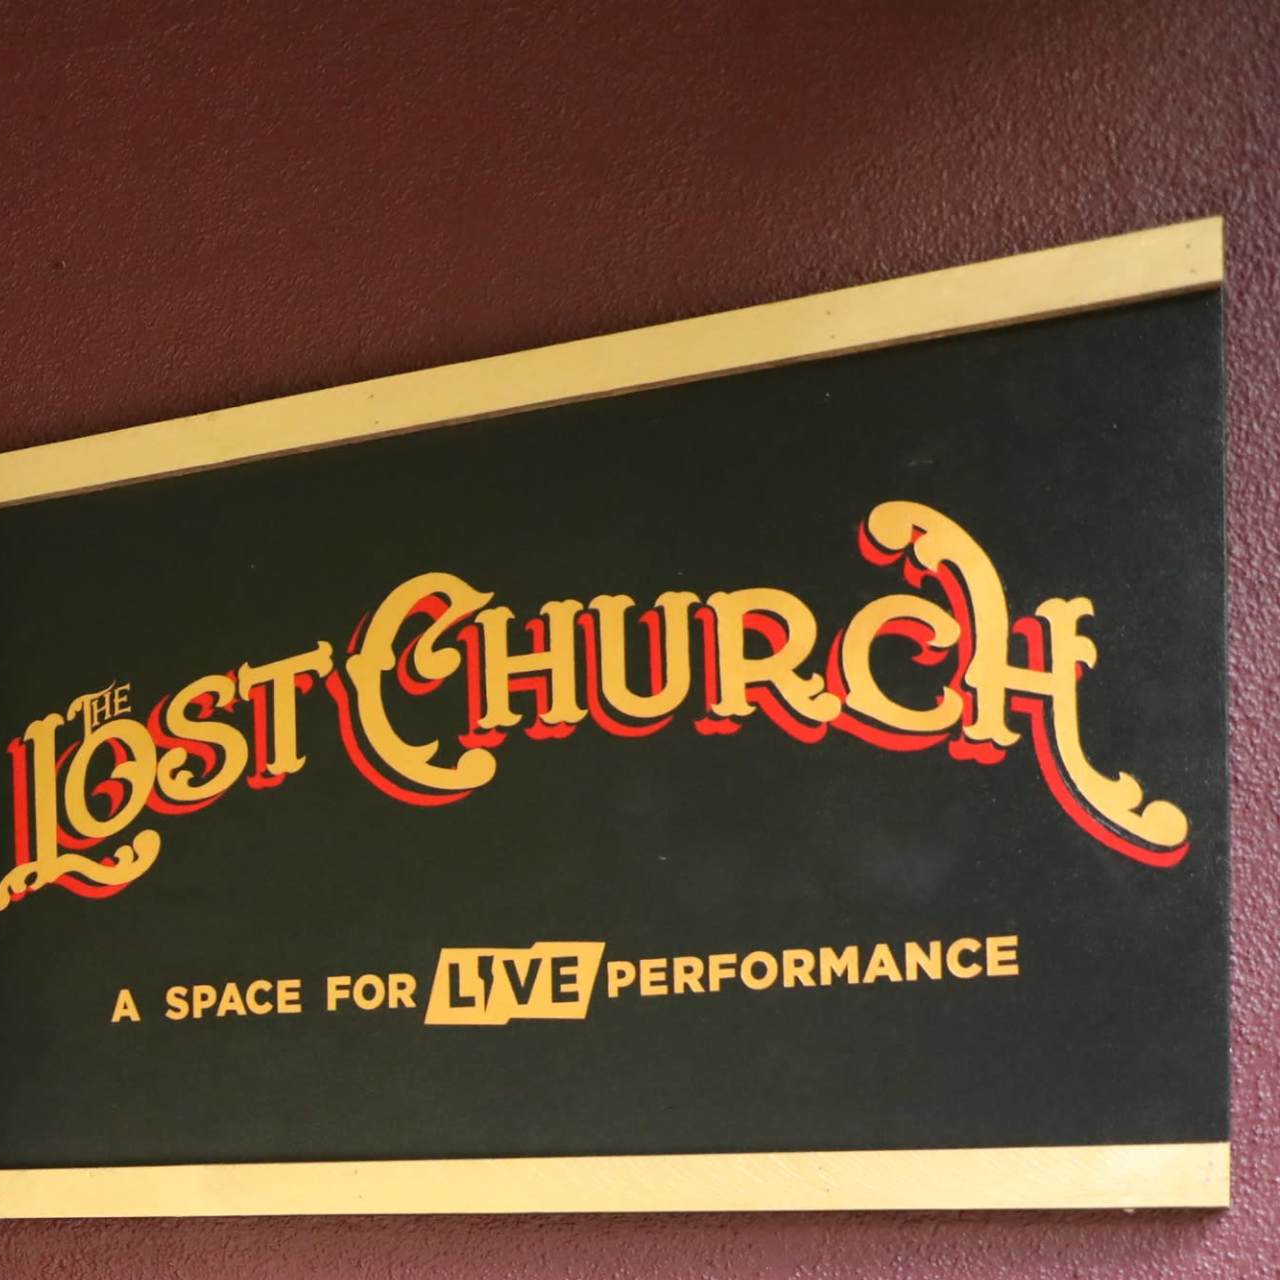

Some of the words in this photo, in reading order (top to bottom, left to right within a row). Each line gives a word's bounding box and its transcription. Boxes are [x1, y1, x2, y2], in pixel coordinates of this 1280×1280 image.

[67, 681, 131, 734] THE
[326, 500, 1190, 868] CHURCH
[111, 989, 140, 1023] A
[165, 979, 302, 1021] SPACE
[326, 973, 417, 1011] FOR
[448, 954, 581, 1012] LIVE
[607, 935, 1020, 998] PERFORMANCE
